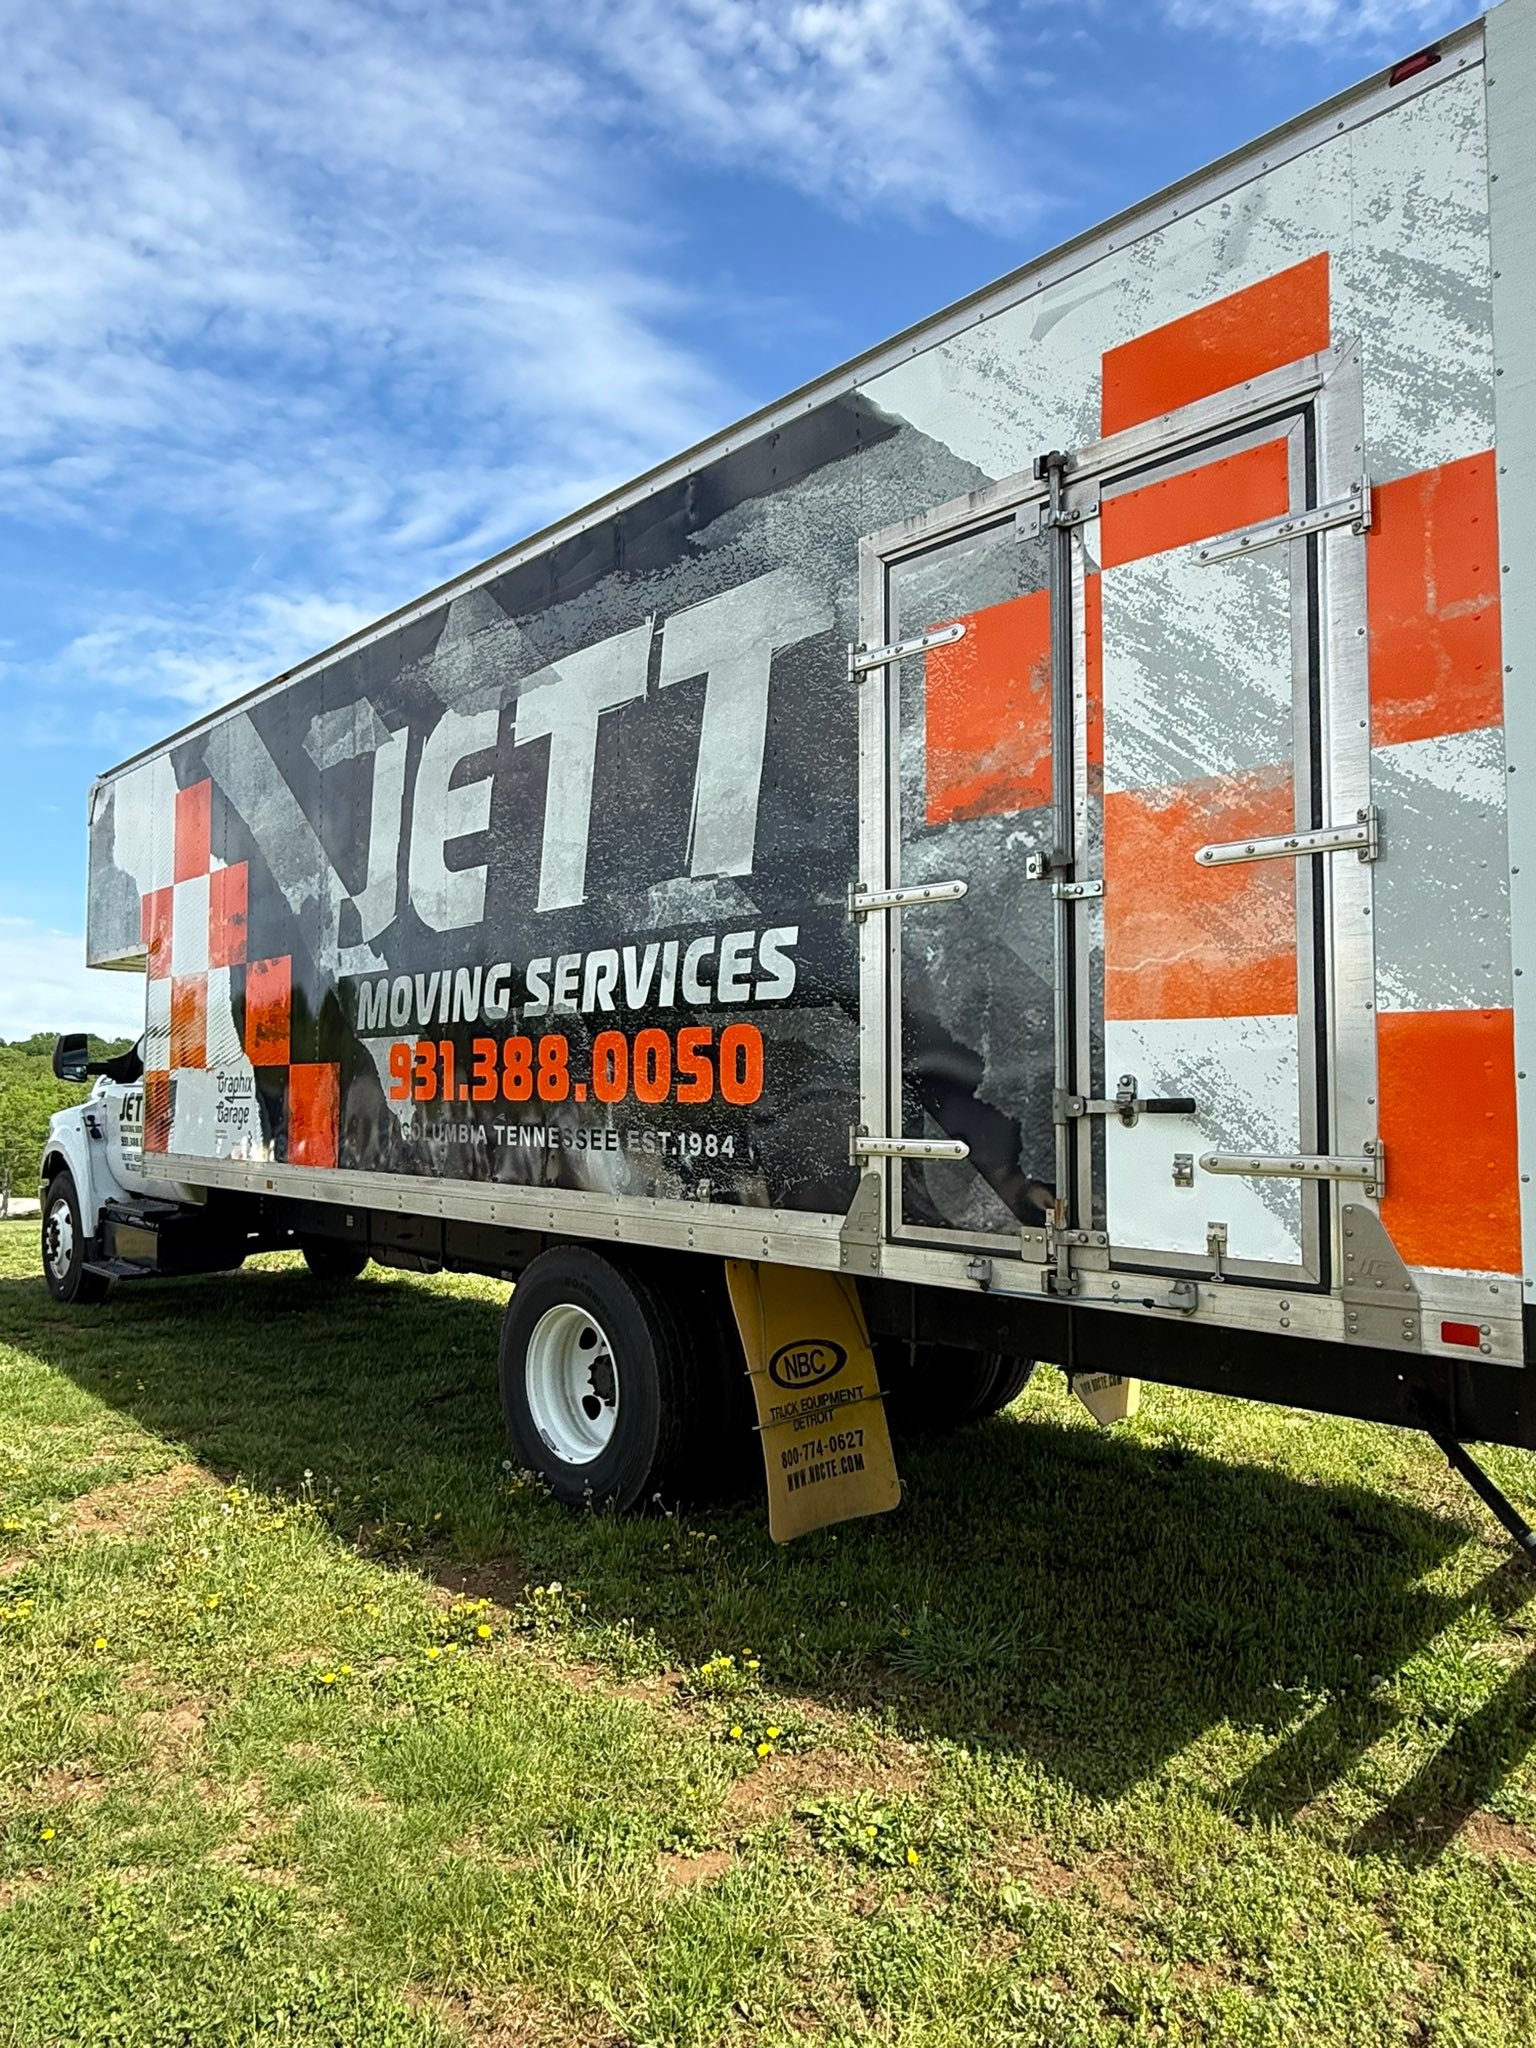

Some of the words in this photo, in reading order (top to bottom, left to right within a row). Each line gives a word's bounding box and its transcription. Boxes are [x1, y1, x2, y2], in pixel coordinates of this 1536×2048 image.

[340, 553, 836, 943] JETT
[356, 962, 512, 1031] MOVING
[523, 926, 799, 1018] SERVICES
[389, 1023, 765, 1105] 931.388.0050
[216, 1071, 253, 1097] Graphix
[216, 1101, 250, 1130] Garage
[401, 1121, 488, 1145] COLUMBIA
[493, 1125, 620, 1151] TENNESSEE
[627, 1130, 735, 1158] EST.1984
[784, 1349, 826, 1381] NBC
[769, 1402, 798, 1421] TRUCK
[801, 1386, 864, 1412] EQUIPMENT
[793, 1408, 835, 1431] DETROIT
[781, 1429, 864, 1469] 800-774-0627
[787, 1453, 865, 1492] WWW.NBCTE.COM
